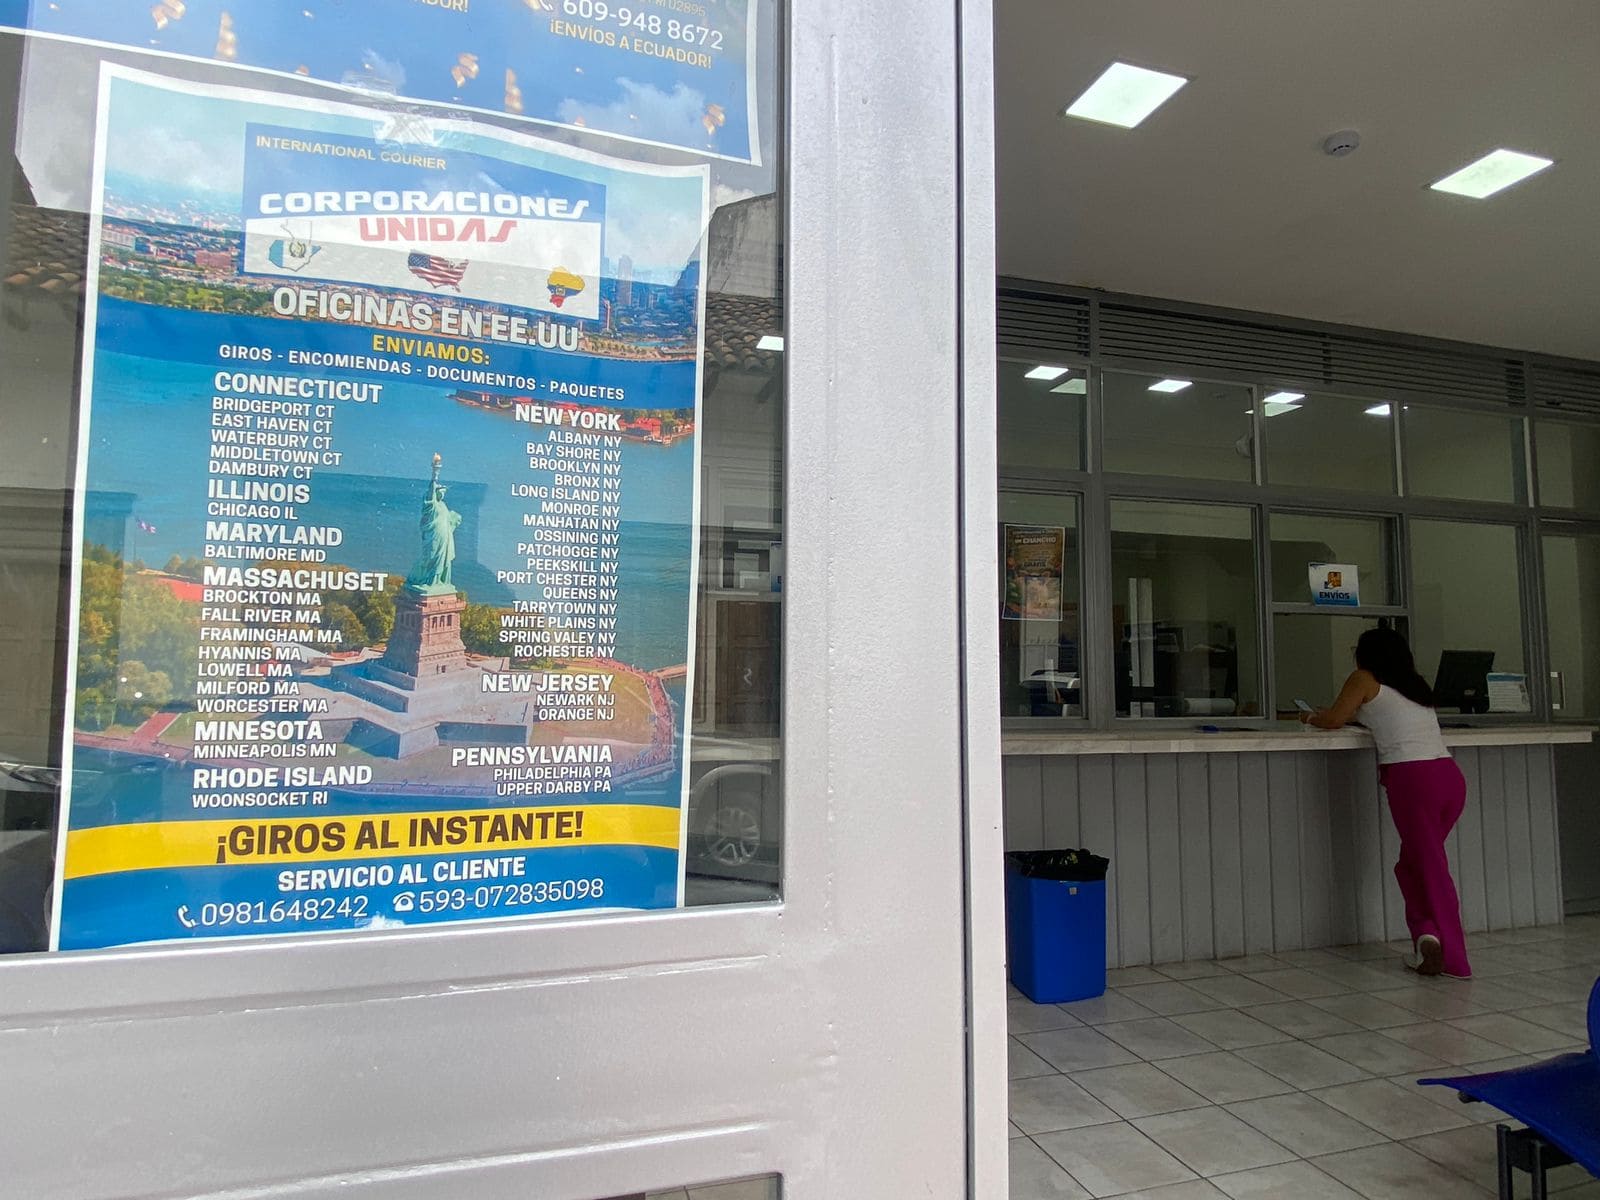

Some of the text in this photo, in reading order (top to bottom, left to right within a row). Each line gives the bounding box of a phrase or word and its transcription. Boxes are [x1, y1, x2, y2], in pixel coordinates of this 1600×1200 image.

[563, 0, 724, 50] 609-948 8672
[550, 19, 712, 69] ¡ENVÍOS A ECUADOR!
[256, 135, 447, 170] INTERNATIONAL COURIER
[259, 190, 589, 219] CORPORACIONES
[359, 217, 517, 243] UNIDAS
[273, 286, 580, 352] OFICINAS EN EE.UU
[372, 334, 491, 364] ENVIAMOS:
[219, 344, 272, 361] GIROS
[288, 351, 411, 375] ENCOMIENDAS
[427, 365, 536, 391] DOCUMENTOS
[549, 380, 625, 401] PAQUETES
[214, 371, 382, 403] CONNECTICUT
[212, 397, 335, 418] BRIDGEPORT CT
[212, 413, 332, 434] EAST HAVEN CT
[515, 403, 621, 431] NEW YORK
[211, 429, 332, 450] WATERBURY CT
[548, 430, 622, 448] ALBANY NY
[210, 445, 342, 466] MIDDLETOWN CT
[526, 442, 622, 462] BAY SHORE NY
[209, 461, 313, 479] DAMBURY CT
[529, 457, 621, 476] BROOKLYN NY
[208, 479, 310, 503] ILLINOIS
[554, 474, 621, 490] BRONX NY
[511, 484, 621, 503] LONG ISLAND NY
[207, 502, 298, 520] CHICAGO IL
[541, 501, 620, 518] MONROE NY
[523, 514, 620, 531] MANHATAN NY
[206, 521, 343, 546] MARYLAND
[534, 529, 619, 545] OSSINING NY
[205, 545, 327, 562] BALTIMORE MD
[517, 543, 619, 559] PATCHOGGE NY
[527, 558, 619, 573] PEEKSKILL NY
[203, 566, 388, 592] MASSACHUSET
[497, 570, 618, 587] PORT CHESTER NY
[203, 590, 321, 606] BROCKTON MA
[543, 586, 618, 600] QUEENS NY
[202, 608, 321, 624] FALL RIVER MA
[512, 600, 618, 615] TARRYTOWN NY
[501, 615, 617, 629] WHITE PLAINS NY
[200, 627, 343, 643] FRAMINGHAM MA
[499, 630, 616, 644] SPRING VALEY NY
[198, 646, 301, 660] HYANNIS MA
[514, 645, 616, 658] ROCHESTER NY
[198, 663, 293, 677] LOWELL MA
[197, 682, 299, 695] MILFORD MA
[482, 674, 614, 692] NEW JERSEY
[197, 699, 328, 713] WORCESTER MA
[536, 694, 615, 706] NEWARK NJ
[538, 708, 614, 721] ORANGE NJ
[194, 720, 323, 741] MINESOTA
[193, 743, 337, 759] MINNEAPOLIS MN
[452, 745, 613, 767] PENNSYLVANIA
[193, 765, 372, 789] RHODE ISLAND
[494, 765, 612, 781] PHILADELPHIA PA
[497, 780, 611, 796] UPPER DARBY PA
[192, 791, 328, 808] WOONSOCKET RI
[215, 810, 585, 864] ¡GIROS AL INSTANTE!
[278, 856, 526, 892] SERVICIO AL CLIENTE
[418, 878, 604, 913] 593-072835098
[201, 895, 368, 927] 0981648242
